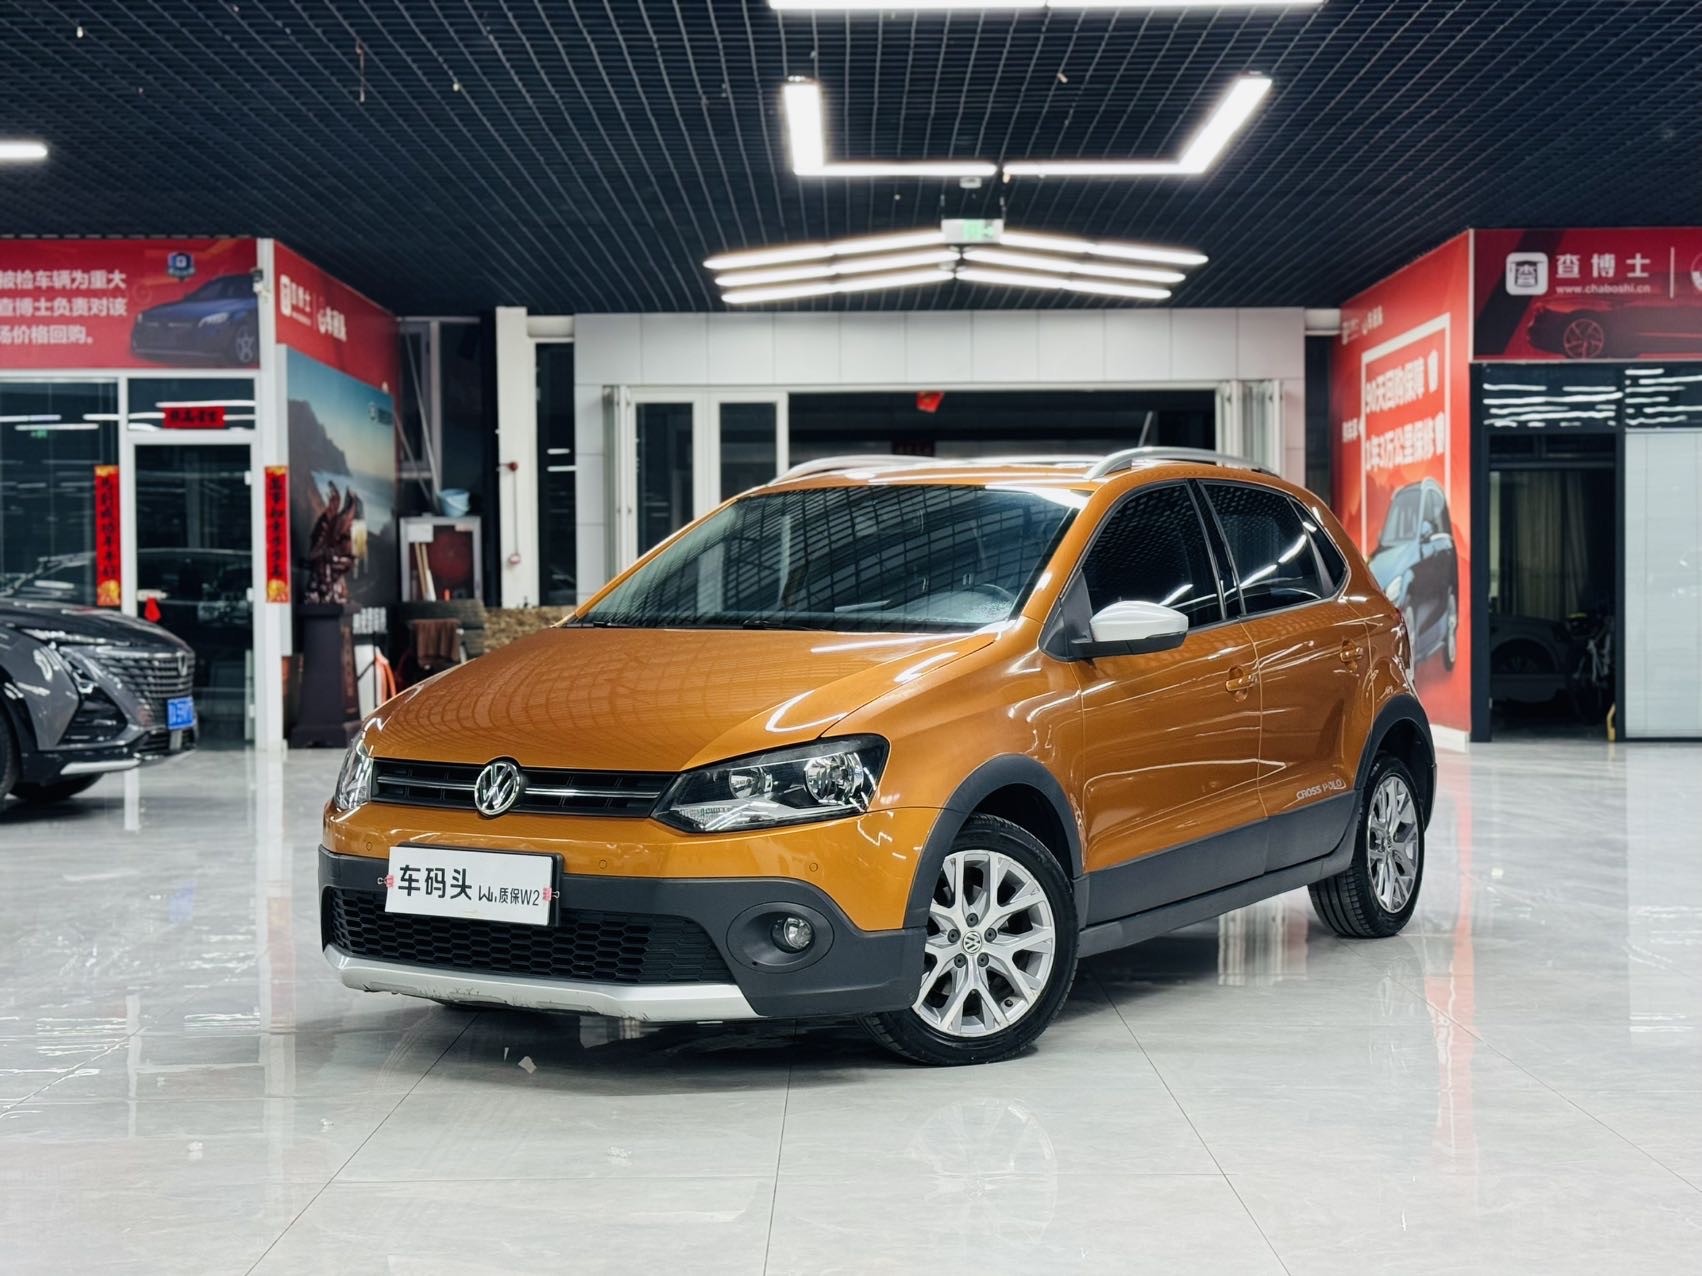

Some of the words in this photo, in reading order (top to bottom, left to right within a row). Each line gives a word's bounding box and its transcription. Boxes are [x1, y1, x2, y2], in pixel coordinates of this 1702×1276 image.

[1556, 252, 1650, 278] 查博士
[1556, 283, 1650, 294] www.chaboshi.cn
[1296, 785, 1322, 800] CROSS
[398, 864, 472, 901] 车码头
